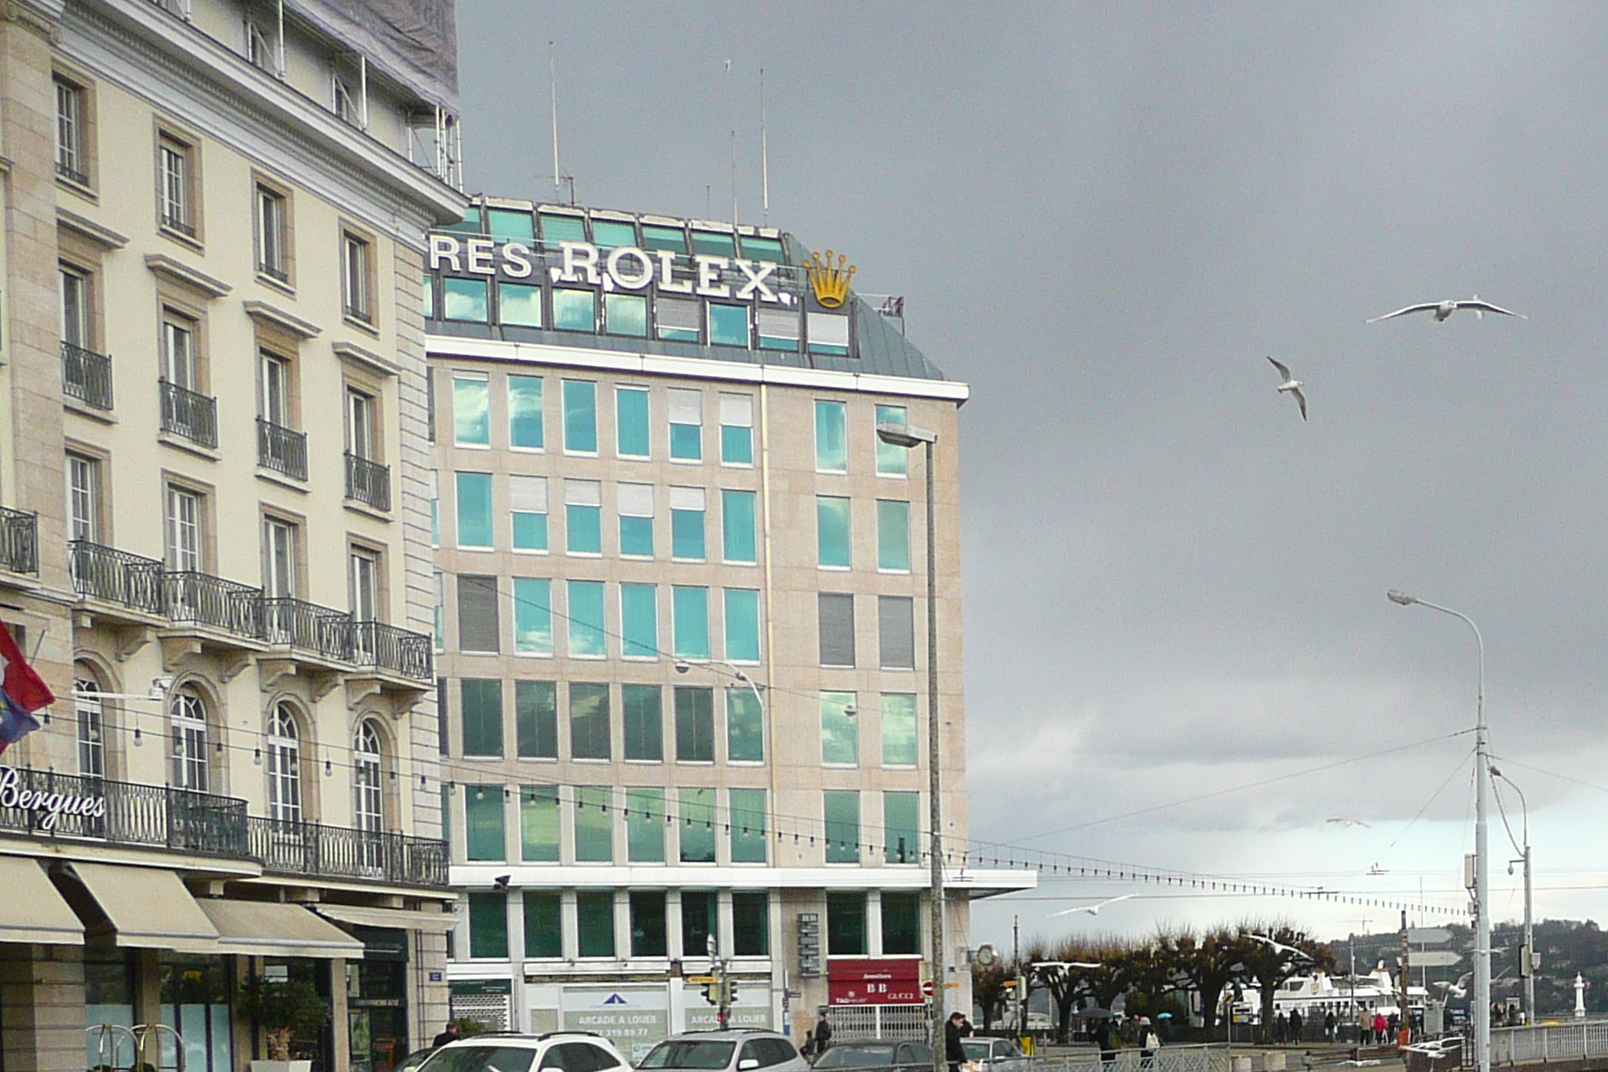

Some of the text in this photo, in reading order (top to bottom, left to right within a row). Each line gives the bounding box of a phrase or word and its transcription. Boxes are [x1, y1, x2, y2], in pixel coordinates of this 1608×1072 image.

[558, 240, 779, 302] ROLEX
[0, 764, 106, 830] Bergues
[578, 1015, 616, 1025] ARCADE
[627, 1015, 657, 1024] LOUER
[738, 1014, 767, 1024] LOUER
